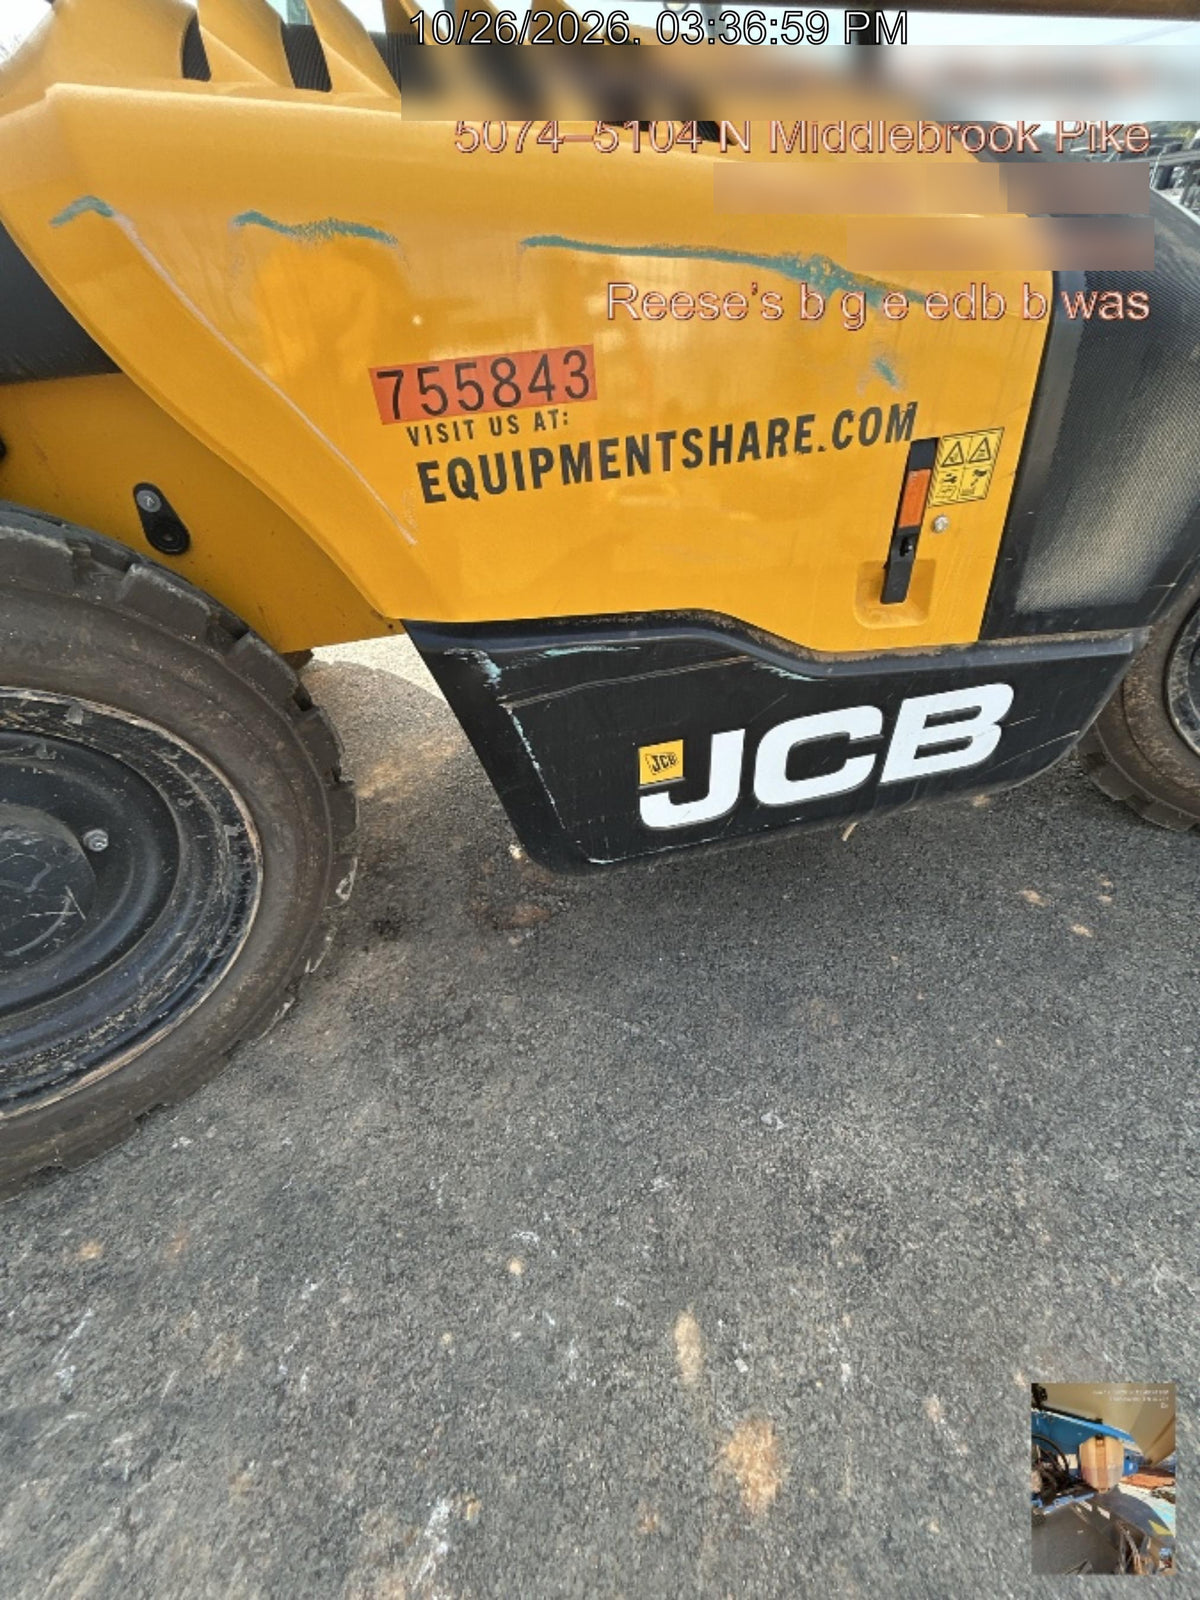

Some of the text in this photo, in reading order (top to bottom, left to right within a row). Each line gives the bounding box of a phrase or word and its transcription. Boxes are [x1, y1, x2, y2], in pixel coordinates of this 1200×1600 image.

[376, 349, 590, 420] 755843
[407, 410, 570, 447] VISIT US AT:
[416, 401, 919, 504] EQUIPMENTSHARE.COM
[639, 683, 1015, 829] JCB
[650, 754, 677, 772] JCB
